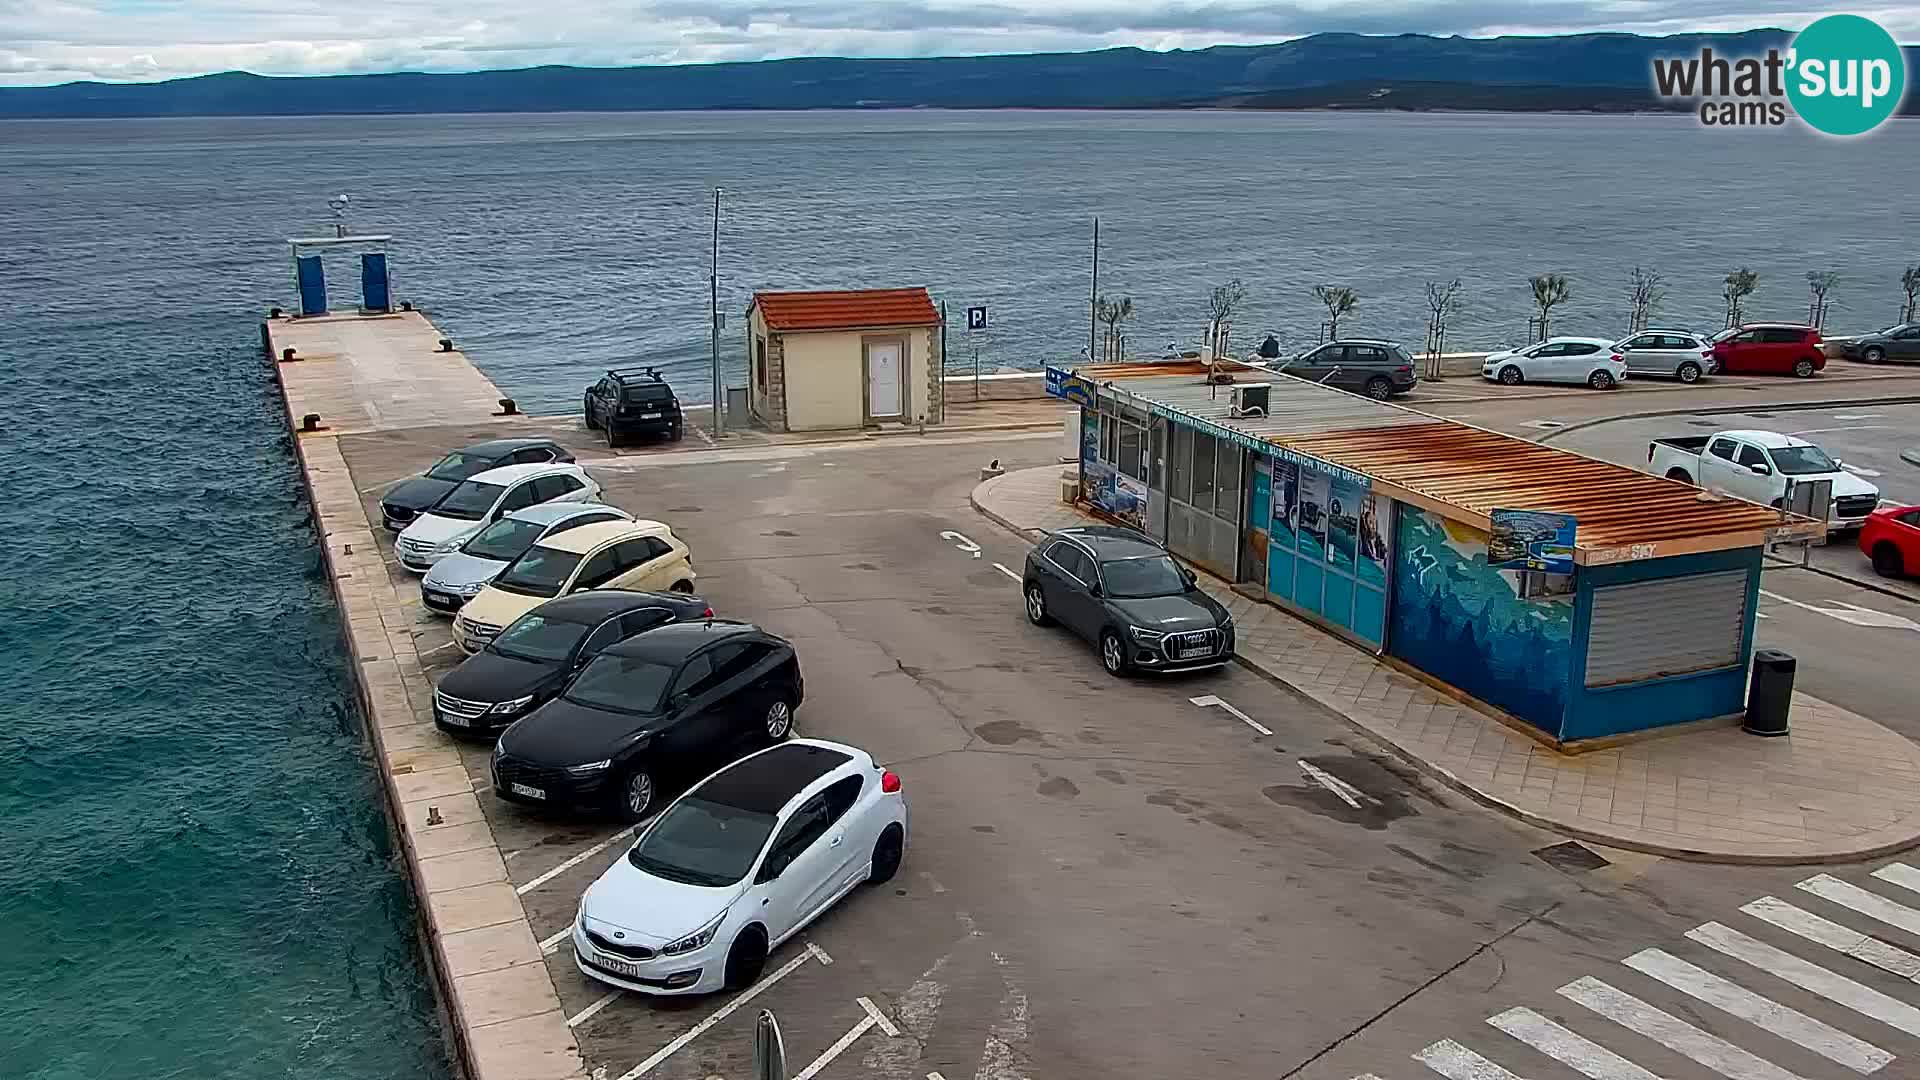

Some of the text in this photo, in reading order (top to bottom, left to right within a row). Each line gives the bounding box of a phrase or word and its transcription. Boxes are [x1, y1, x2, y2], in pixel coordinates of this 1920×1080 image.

[973, 310, 982, 326] P
[1230, 432, 1259, 450] POSTAJA
[1269, 446, 1284, 458] BUS
[1284, 450, 1314, 469] STATION
[1316, 460, 1341, 477] TICKET
[1342, 469, 1369, 487] OFFICE
